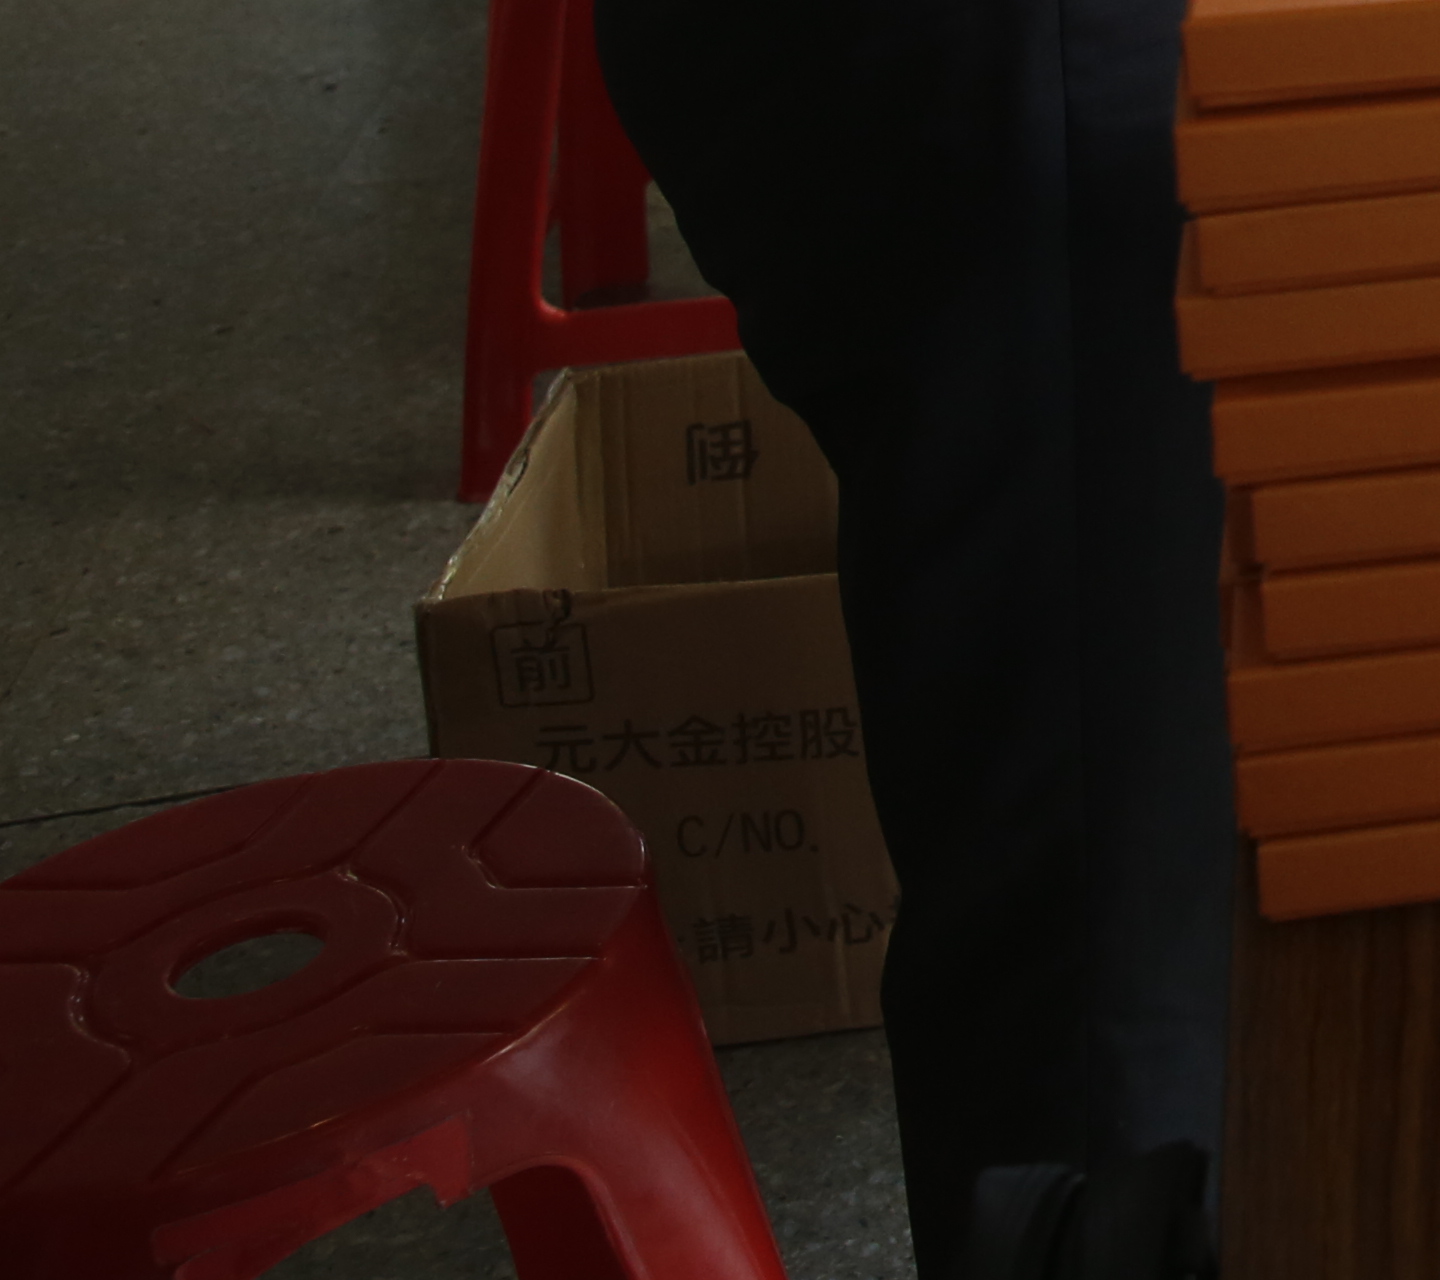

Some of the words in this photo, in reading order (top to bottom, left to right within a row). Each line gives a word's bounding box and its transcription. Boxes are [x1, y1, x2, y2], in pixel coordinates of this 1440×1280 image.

[511, 639, 571, 694] 前
[536, 707, 860, 774] 元大金控股
[676, 809, 820, 859] C/NO.
[676, 893, 900, 964] 請小心
